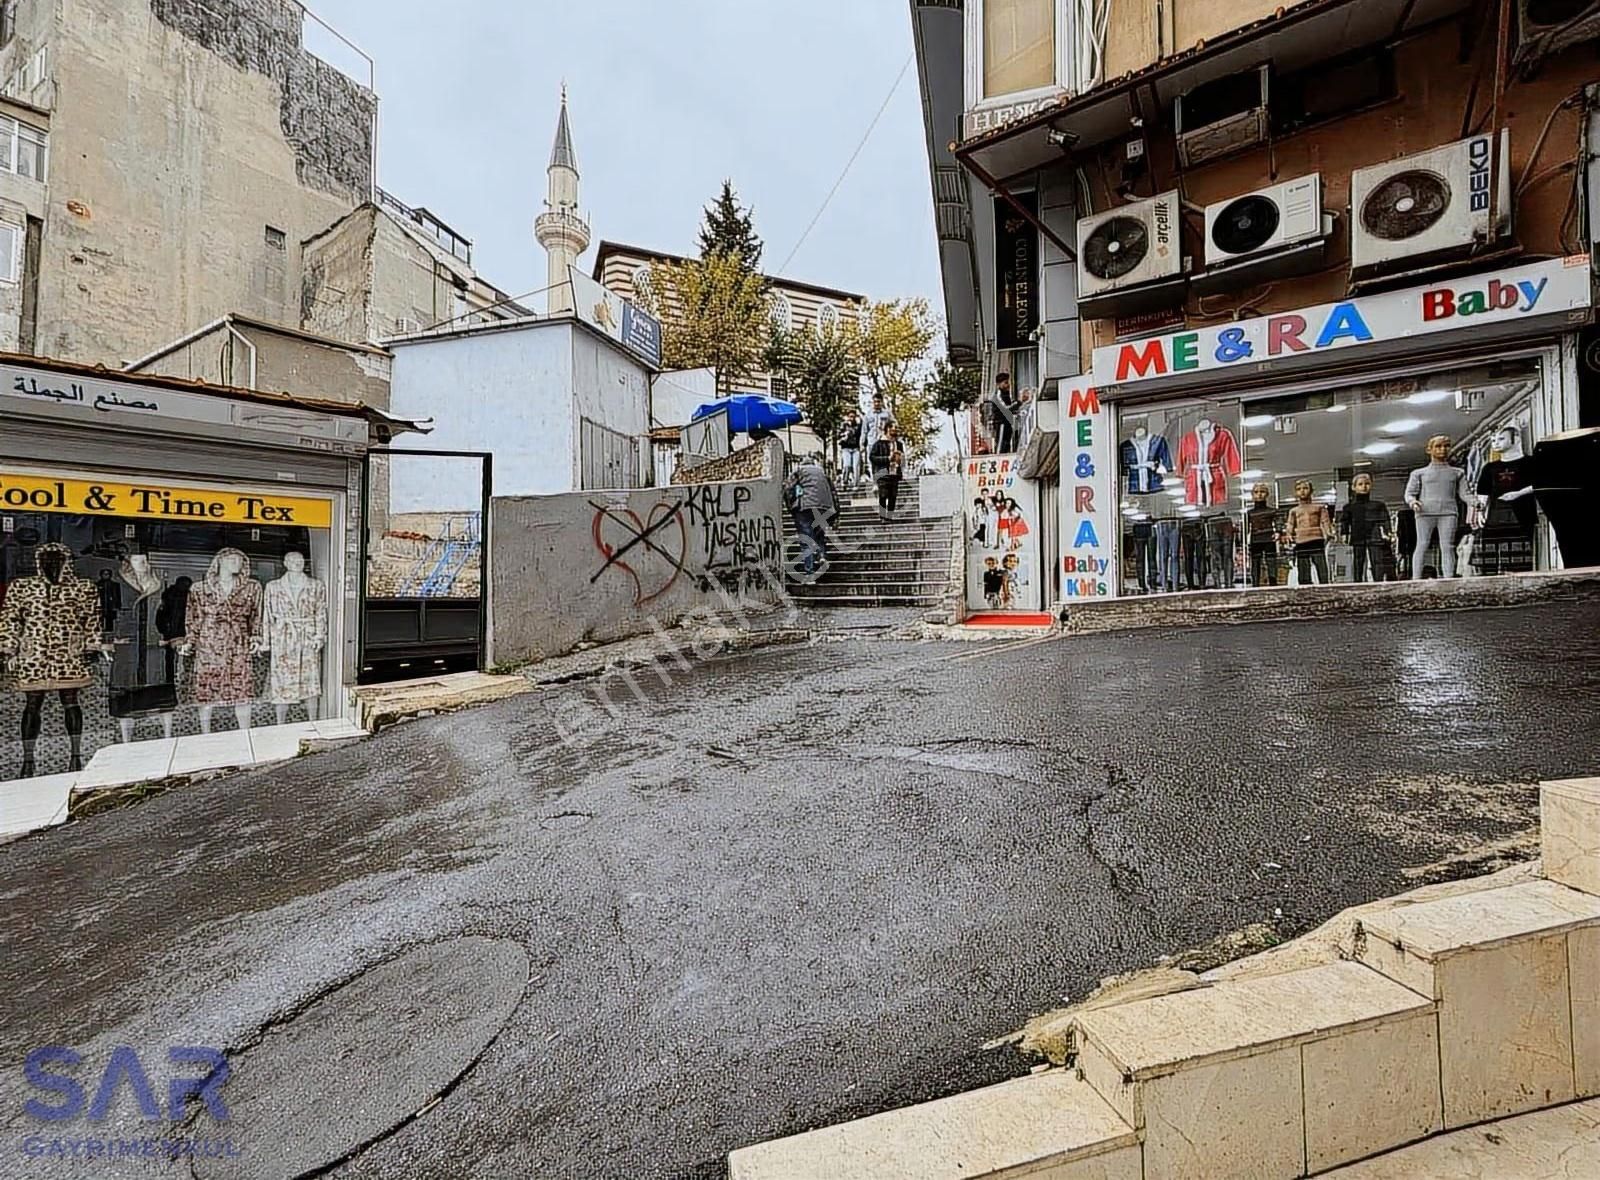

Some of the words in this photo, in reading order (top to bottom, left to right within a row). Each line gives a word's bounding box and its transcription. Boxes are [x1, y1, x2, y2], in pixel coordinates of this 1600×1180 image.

[1469, 138, 1489, 212] BEKO
[1155, 200, 1172, 244] arçelik
[1423, 276, 1549, 322] Baby
[13, 376, 84, 403] الجملة
[93, 392, 159, 412] مصنع
[977, 476, 1015, 488] Baby
[0, 483, 67, 509] ool
[83, 486, 116, 511] &
[130, 488, 225, 518] Time
[237, 497, 294, 522] Tex
[684, 485, 752, 526] KALP
[1064, 554, 1110, 575] Baby
[1066, 578, 1108, 597] Kids
